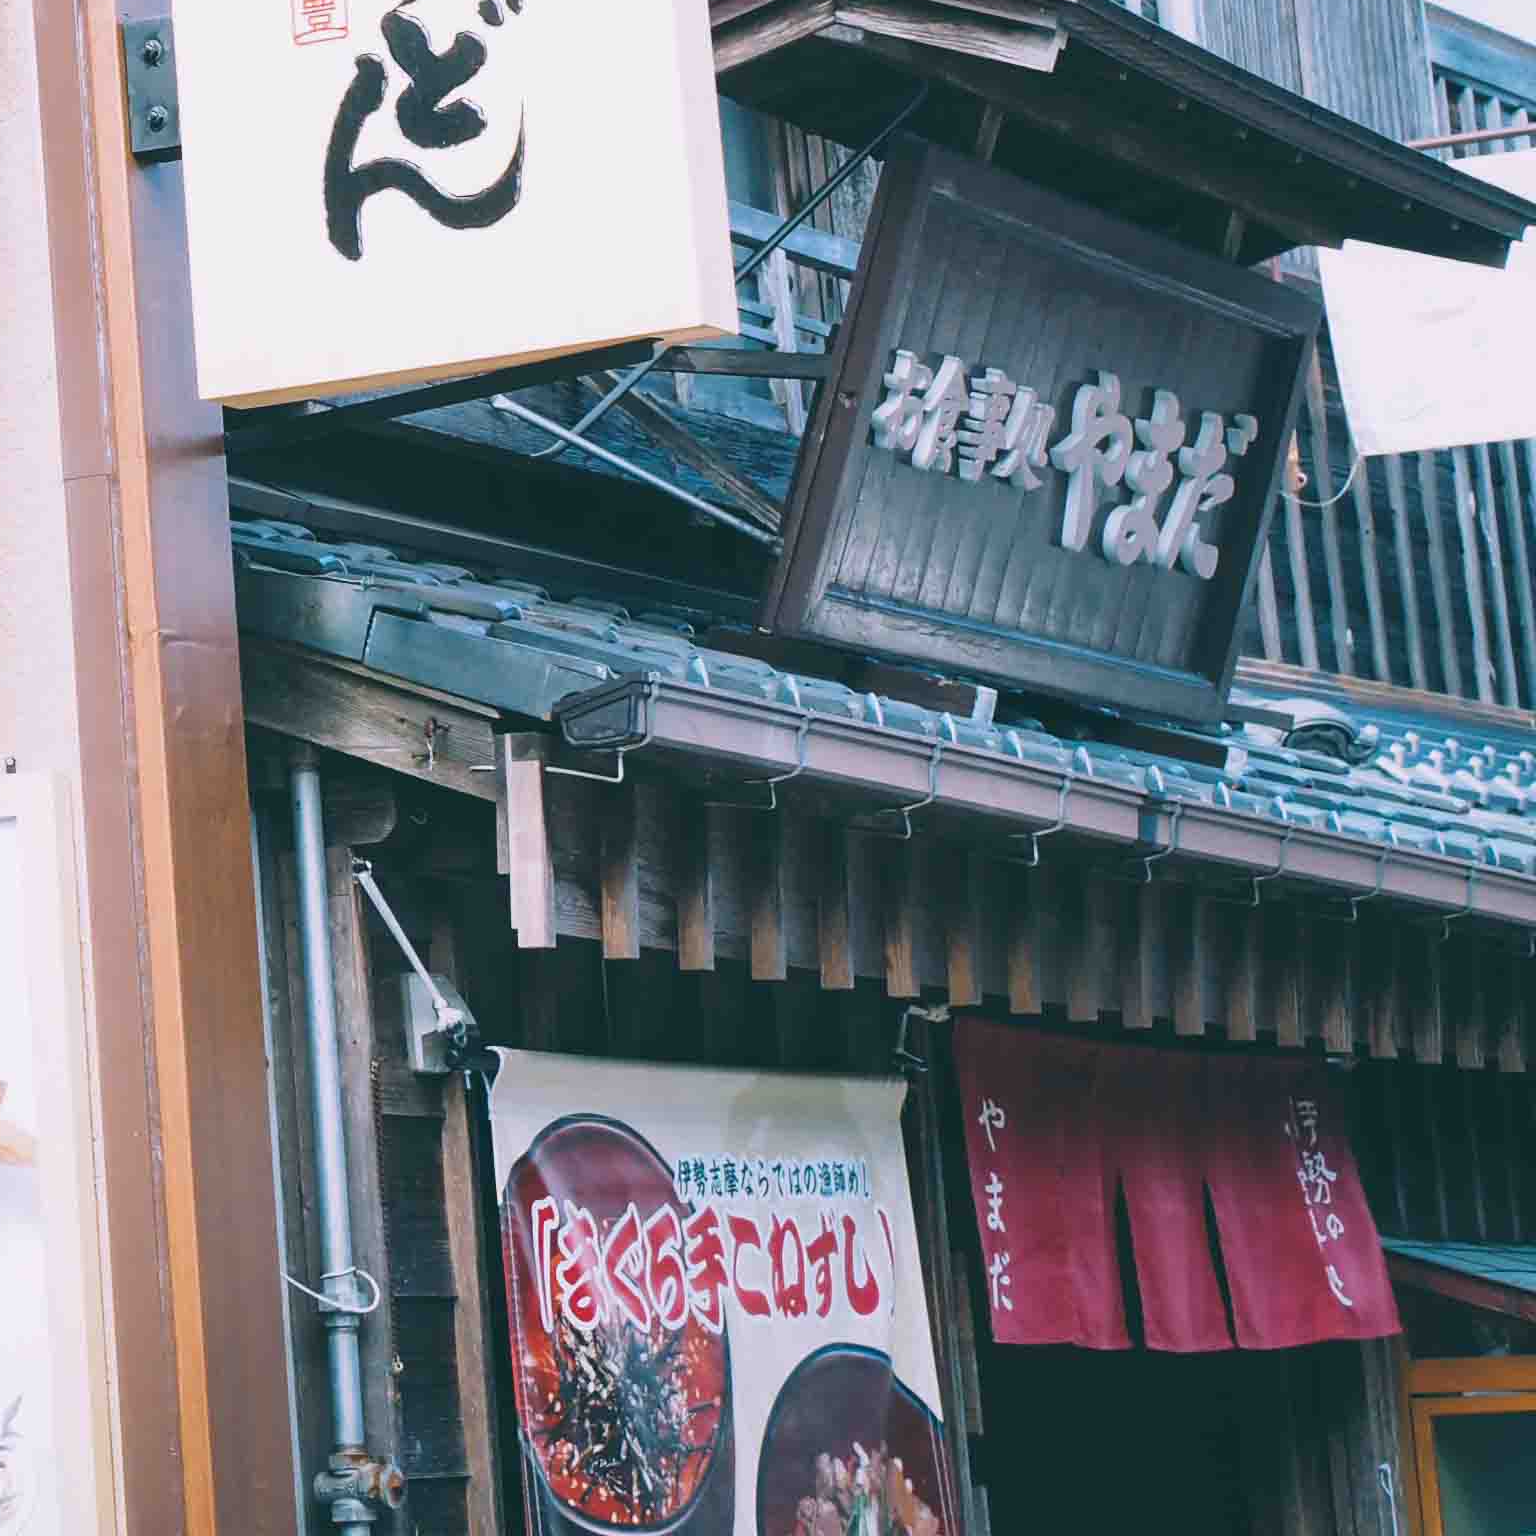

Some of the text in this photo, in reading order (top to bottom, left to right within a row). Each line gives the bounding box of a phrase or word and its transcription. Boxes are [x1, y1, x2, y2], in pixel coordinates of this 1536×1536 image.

[1050, 369, 1259, 580] やまだ
[978, 1098, 1014, 1312] やまだ
